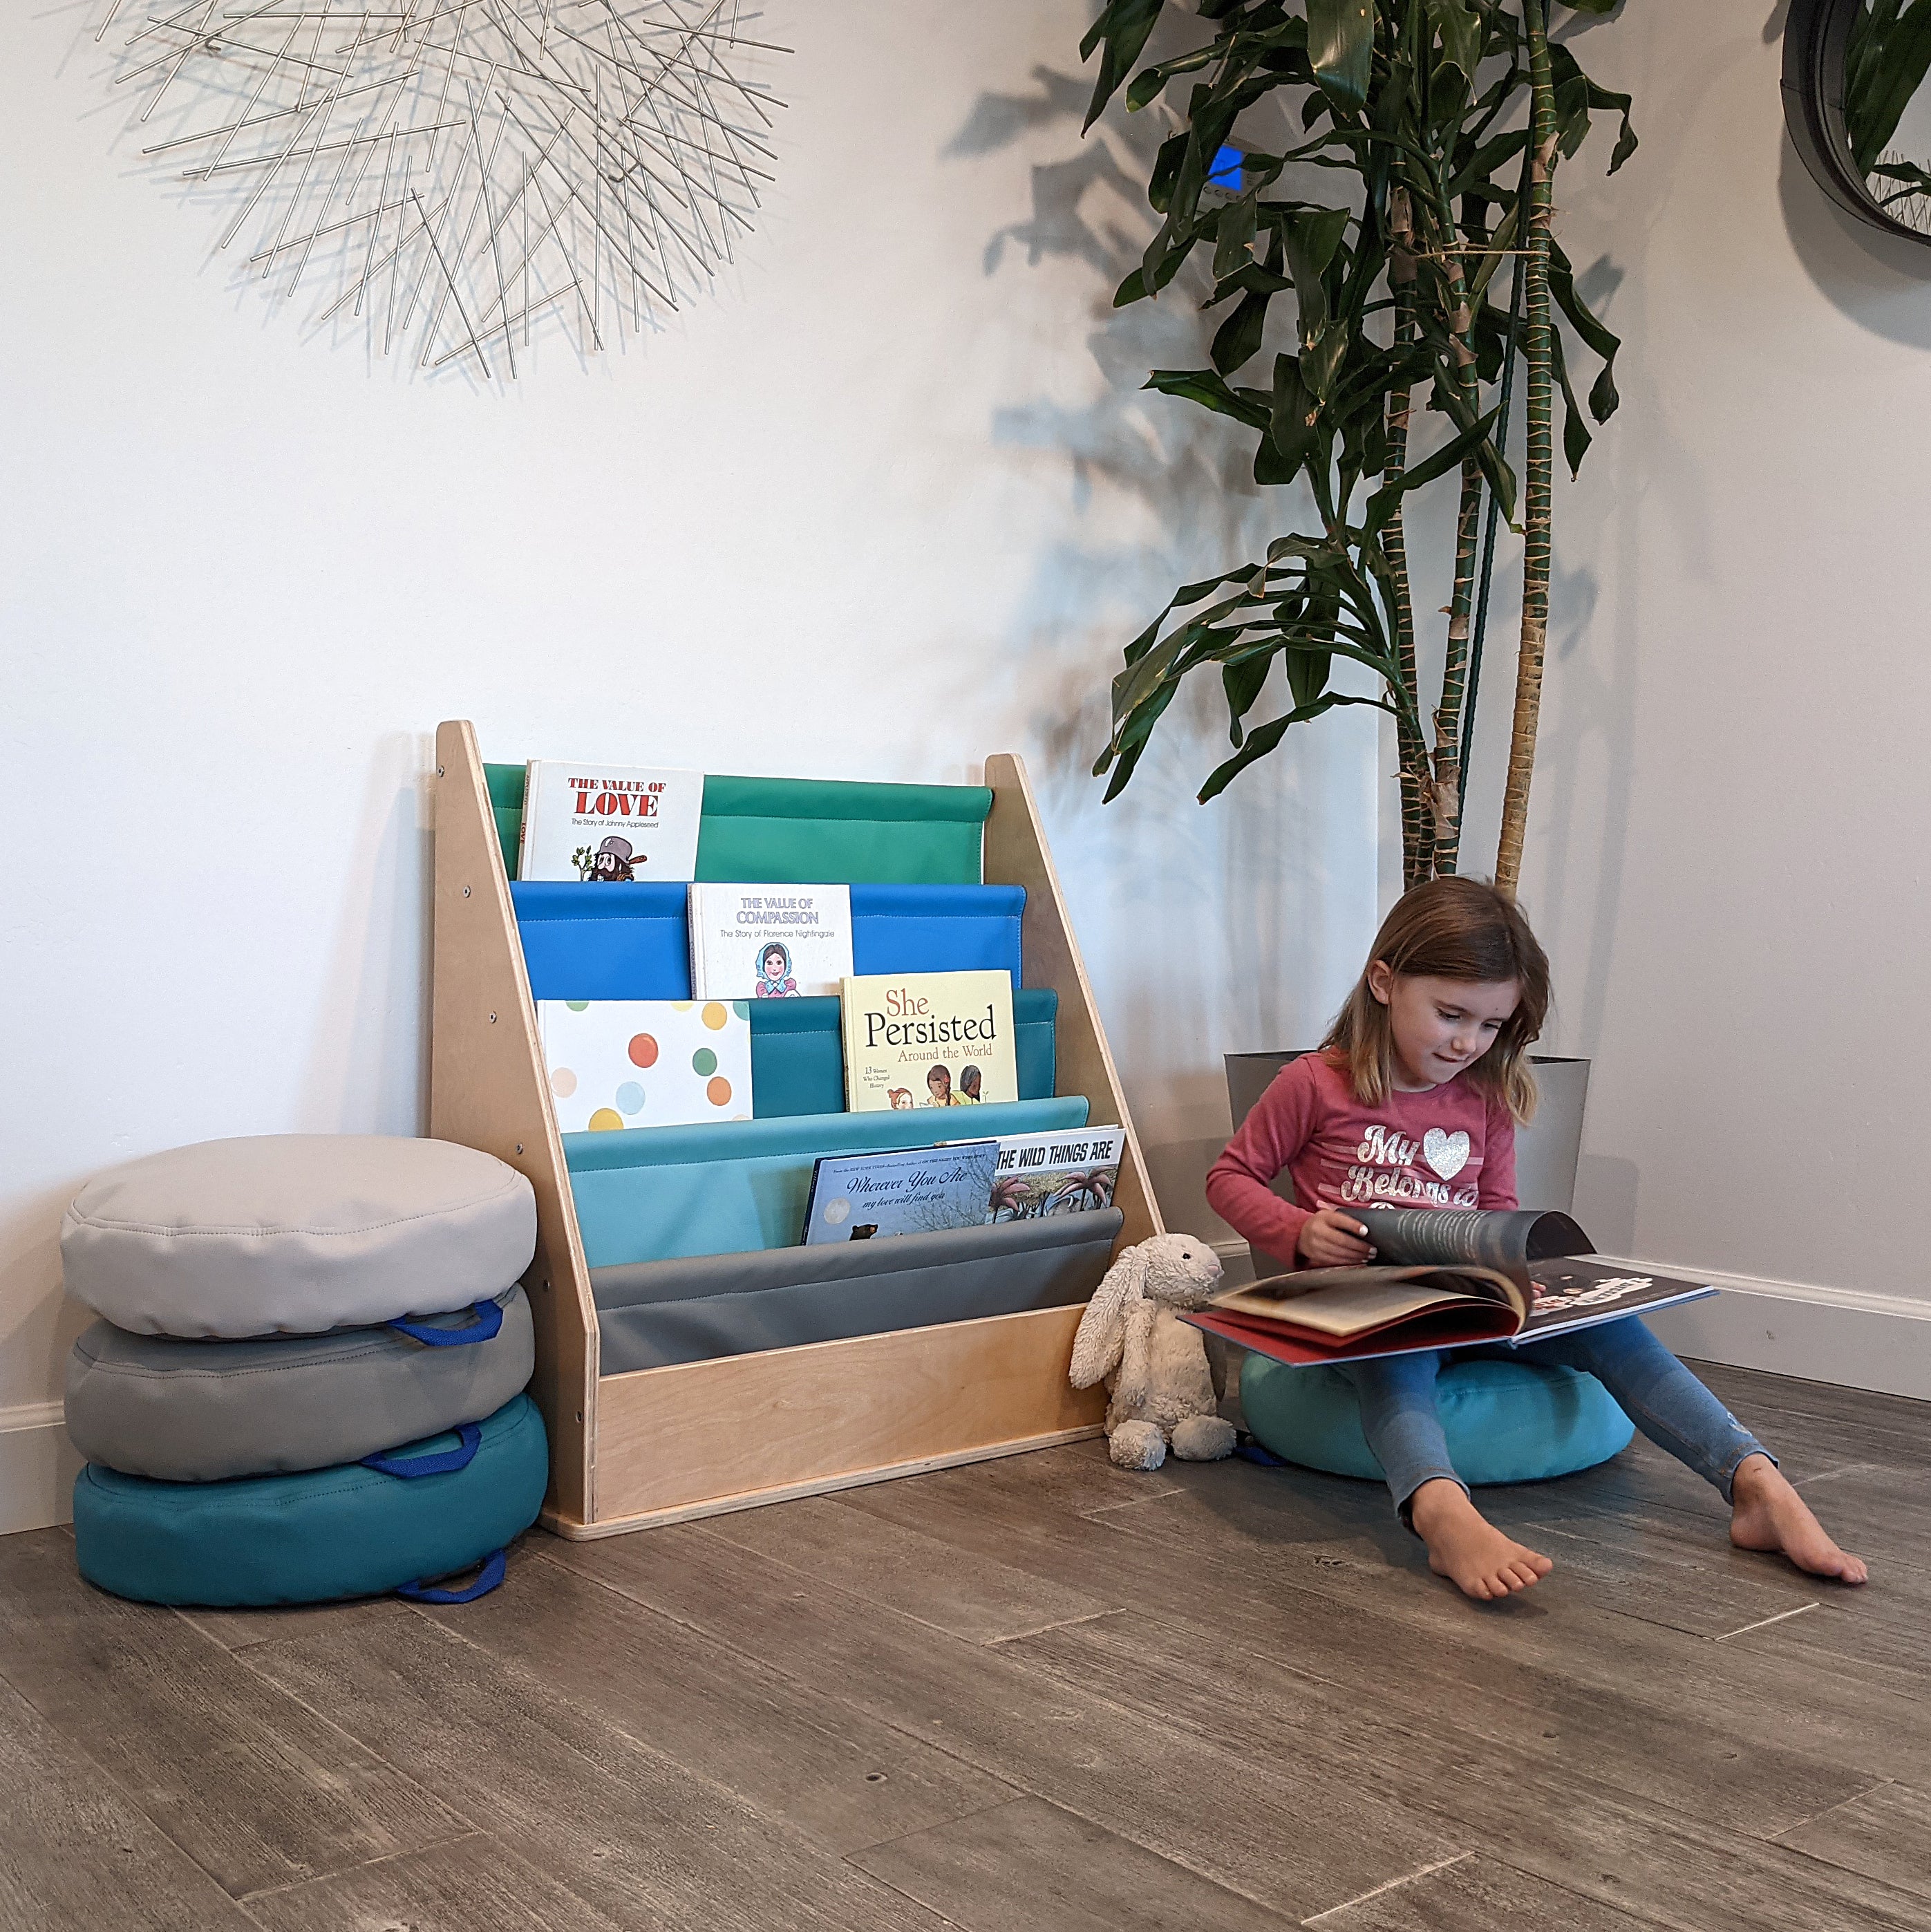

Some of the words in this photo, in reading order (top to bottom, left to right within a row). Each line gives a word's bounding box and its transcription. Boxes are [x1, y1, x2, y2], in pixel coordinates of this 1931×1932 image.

[567, 778, 599, 789] THE
[601, 779, 645, 792] VALUE
[648, 782, 667, 793] OF
[573, 791, 659, 817] LOVE
[583, 818, 598, 827] Story
[605, 820, 626, 828] Johnny
[740, 897, 762, 908] THE
[764, 898, 796, 908] VALUE
[798, 898, 813, 909] OF
[736, 910, 819, 924] COMPASSION
[735, 929, 753, 939] Story
[795, 929, 835, 939] Nightingale
[885, 988, 930, 1017] She
[864, 1004, 997, 1048] Persisted
[897, 1047, 939, 1062] Around
[943, 1046, 959, 1058] the
[962, 1043, 992, 1057] World
[865, 1066, 872, 1074] 13
[1357, 1125, 1420, 1165] My
[996, 1150, 1017, 1170] THE
[1018, 1147, 1046, 1167] WILD
[1049, 1143, 1088, 1164] THINGS
[1089, 1140, 1113, 1160] ARE
[847, 1176, 903, 1194] Wherever
[905, 1170, 936, 1193] You
[939, 1166, 968, 1184] Are
[1341, 1165, 1451, 1208] Belongs
[863, 1201, 875, 1210] my
[877, 1197, 894, 1206] love
[894, 1194, 909, 1204] will
[909, 1192, 931, 1206] find
[931, 1192, 945, 1203] you
